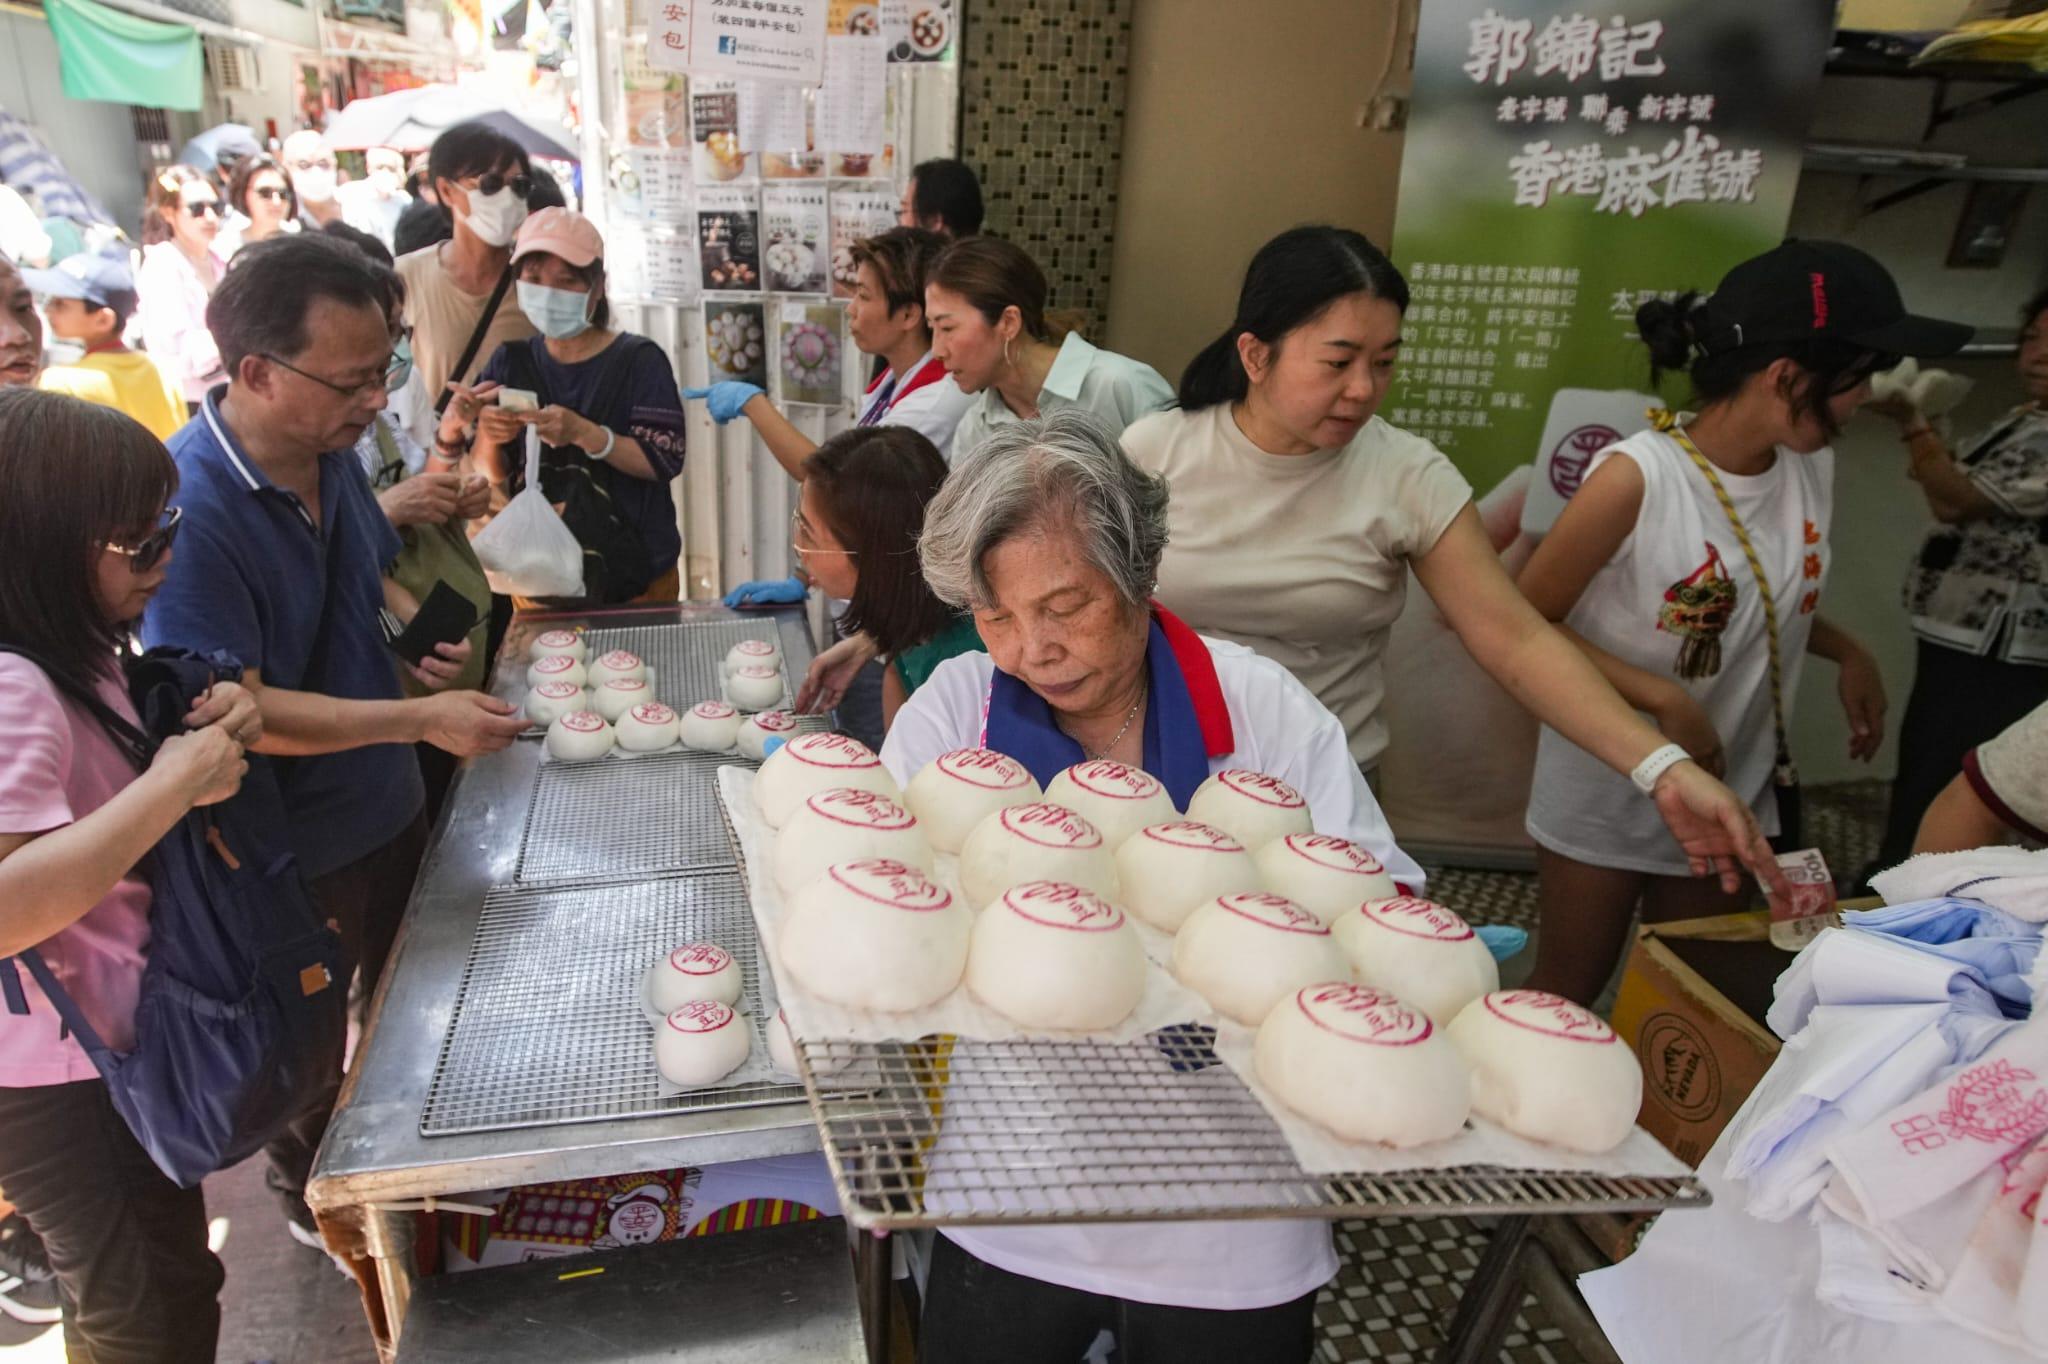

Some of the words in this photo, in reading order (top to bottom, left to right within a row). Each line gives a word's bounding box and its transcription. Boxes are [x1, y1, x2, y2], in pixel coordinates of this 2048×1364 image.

[1462, 8, 1666, 86] 郭錦記
[1497, 96, 1568, 121] 老字號
[1638, 93, 1715, 120] 新字號
[1508, 125, 1762, 218] 香港麻雀號
[1803, 850, 1826, 882] 100
